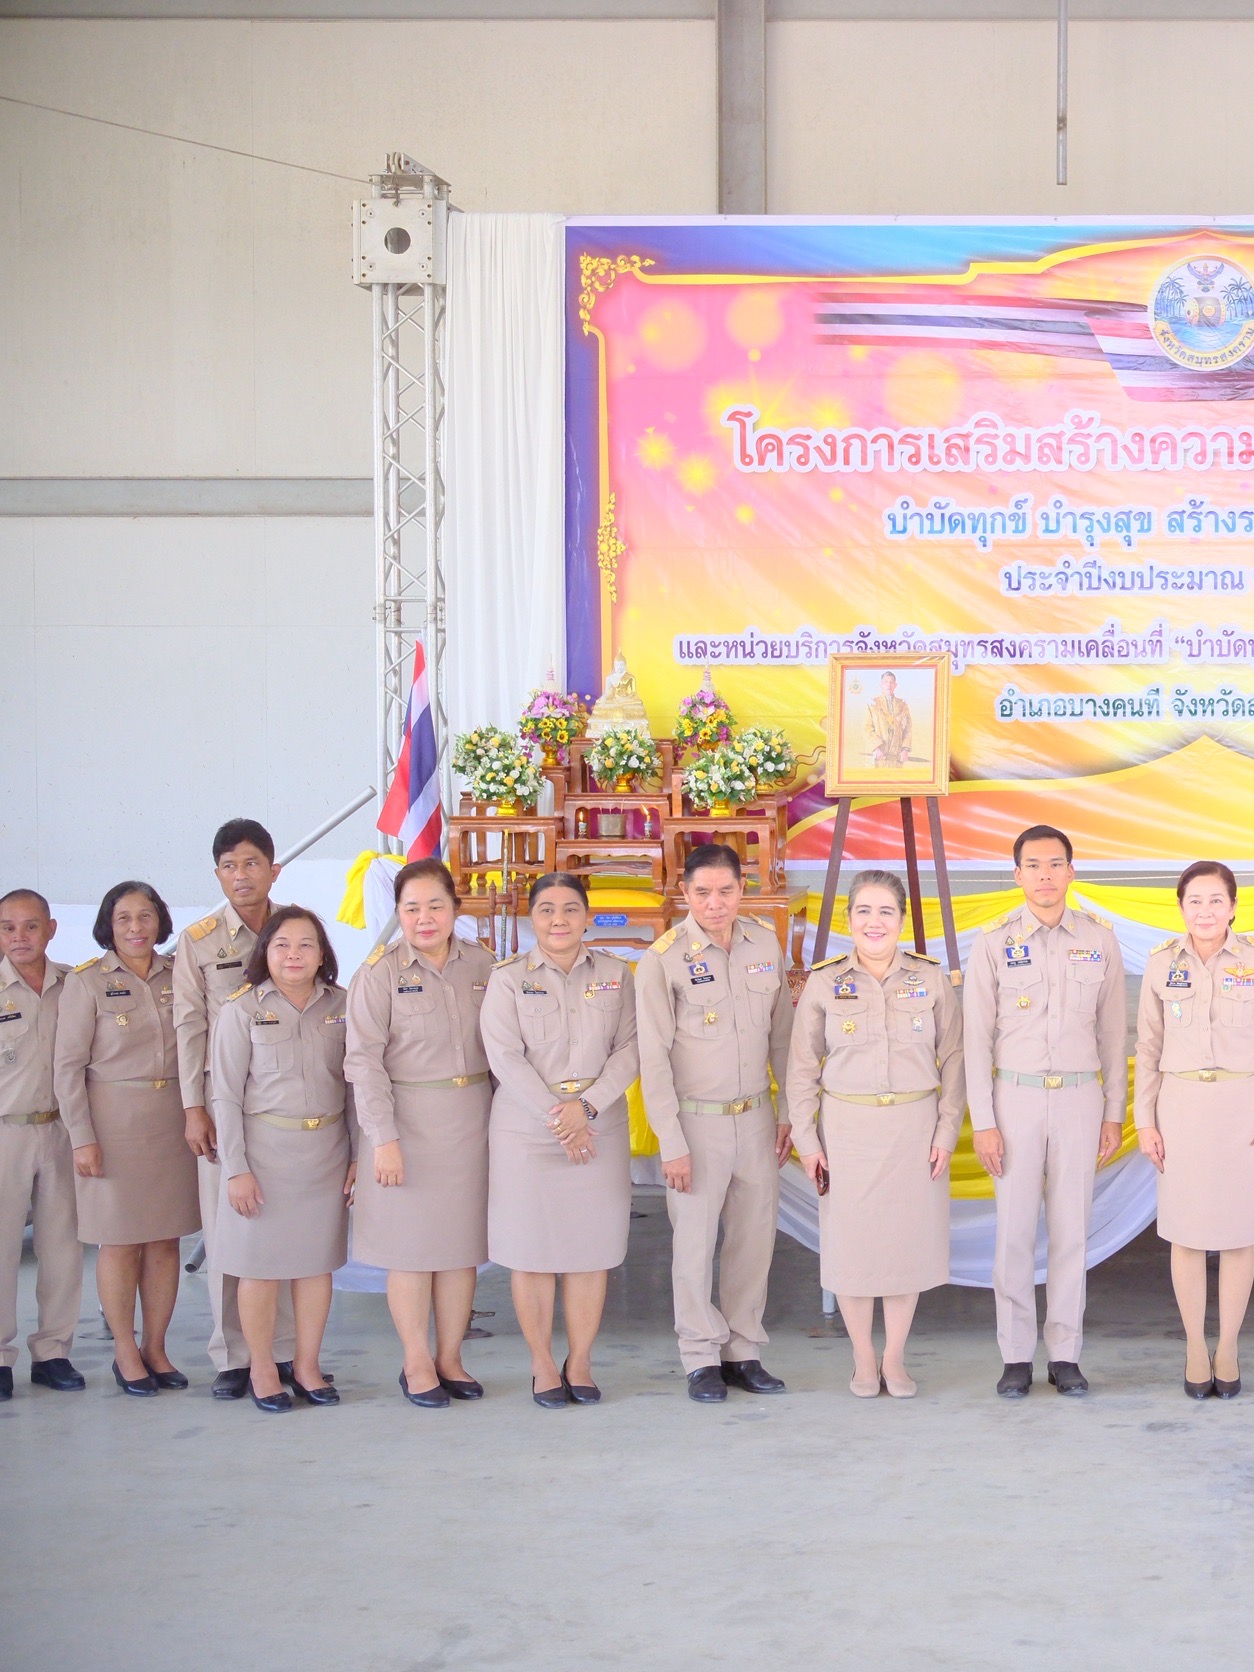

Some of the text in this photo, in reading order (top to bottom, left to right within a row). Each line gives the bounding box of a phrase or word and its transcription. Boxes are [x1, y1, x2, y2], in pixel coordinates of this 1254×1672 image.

[887, 498, 1029, 548] บำบัดทุกข์
[1039, 501, 1153, 548] บำรุงสุข
[1003, 560, 1244, 592] ประจำปีงบประมาณ
[998, 687, 1161, 719] อำเภอบางคนที
